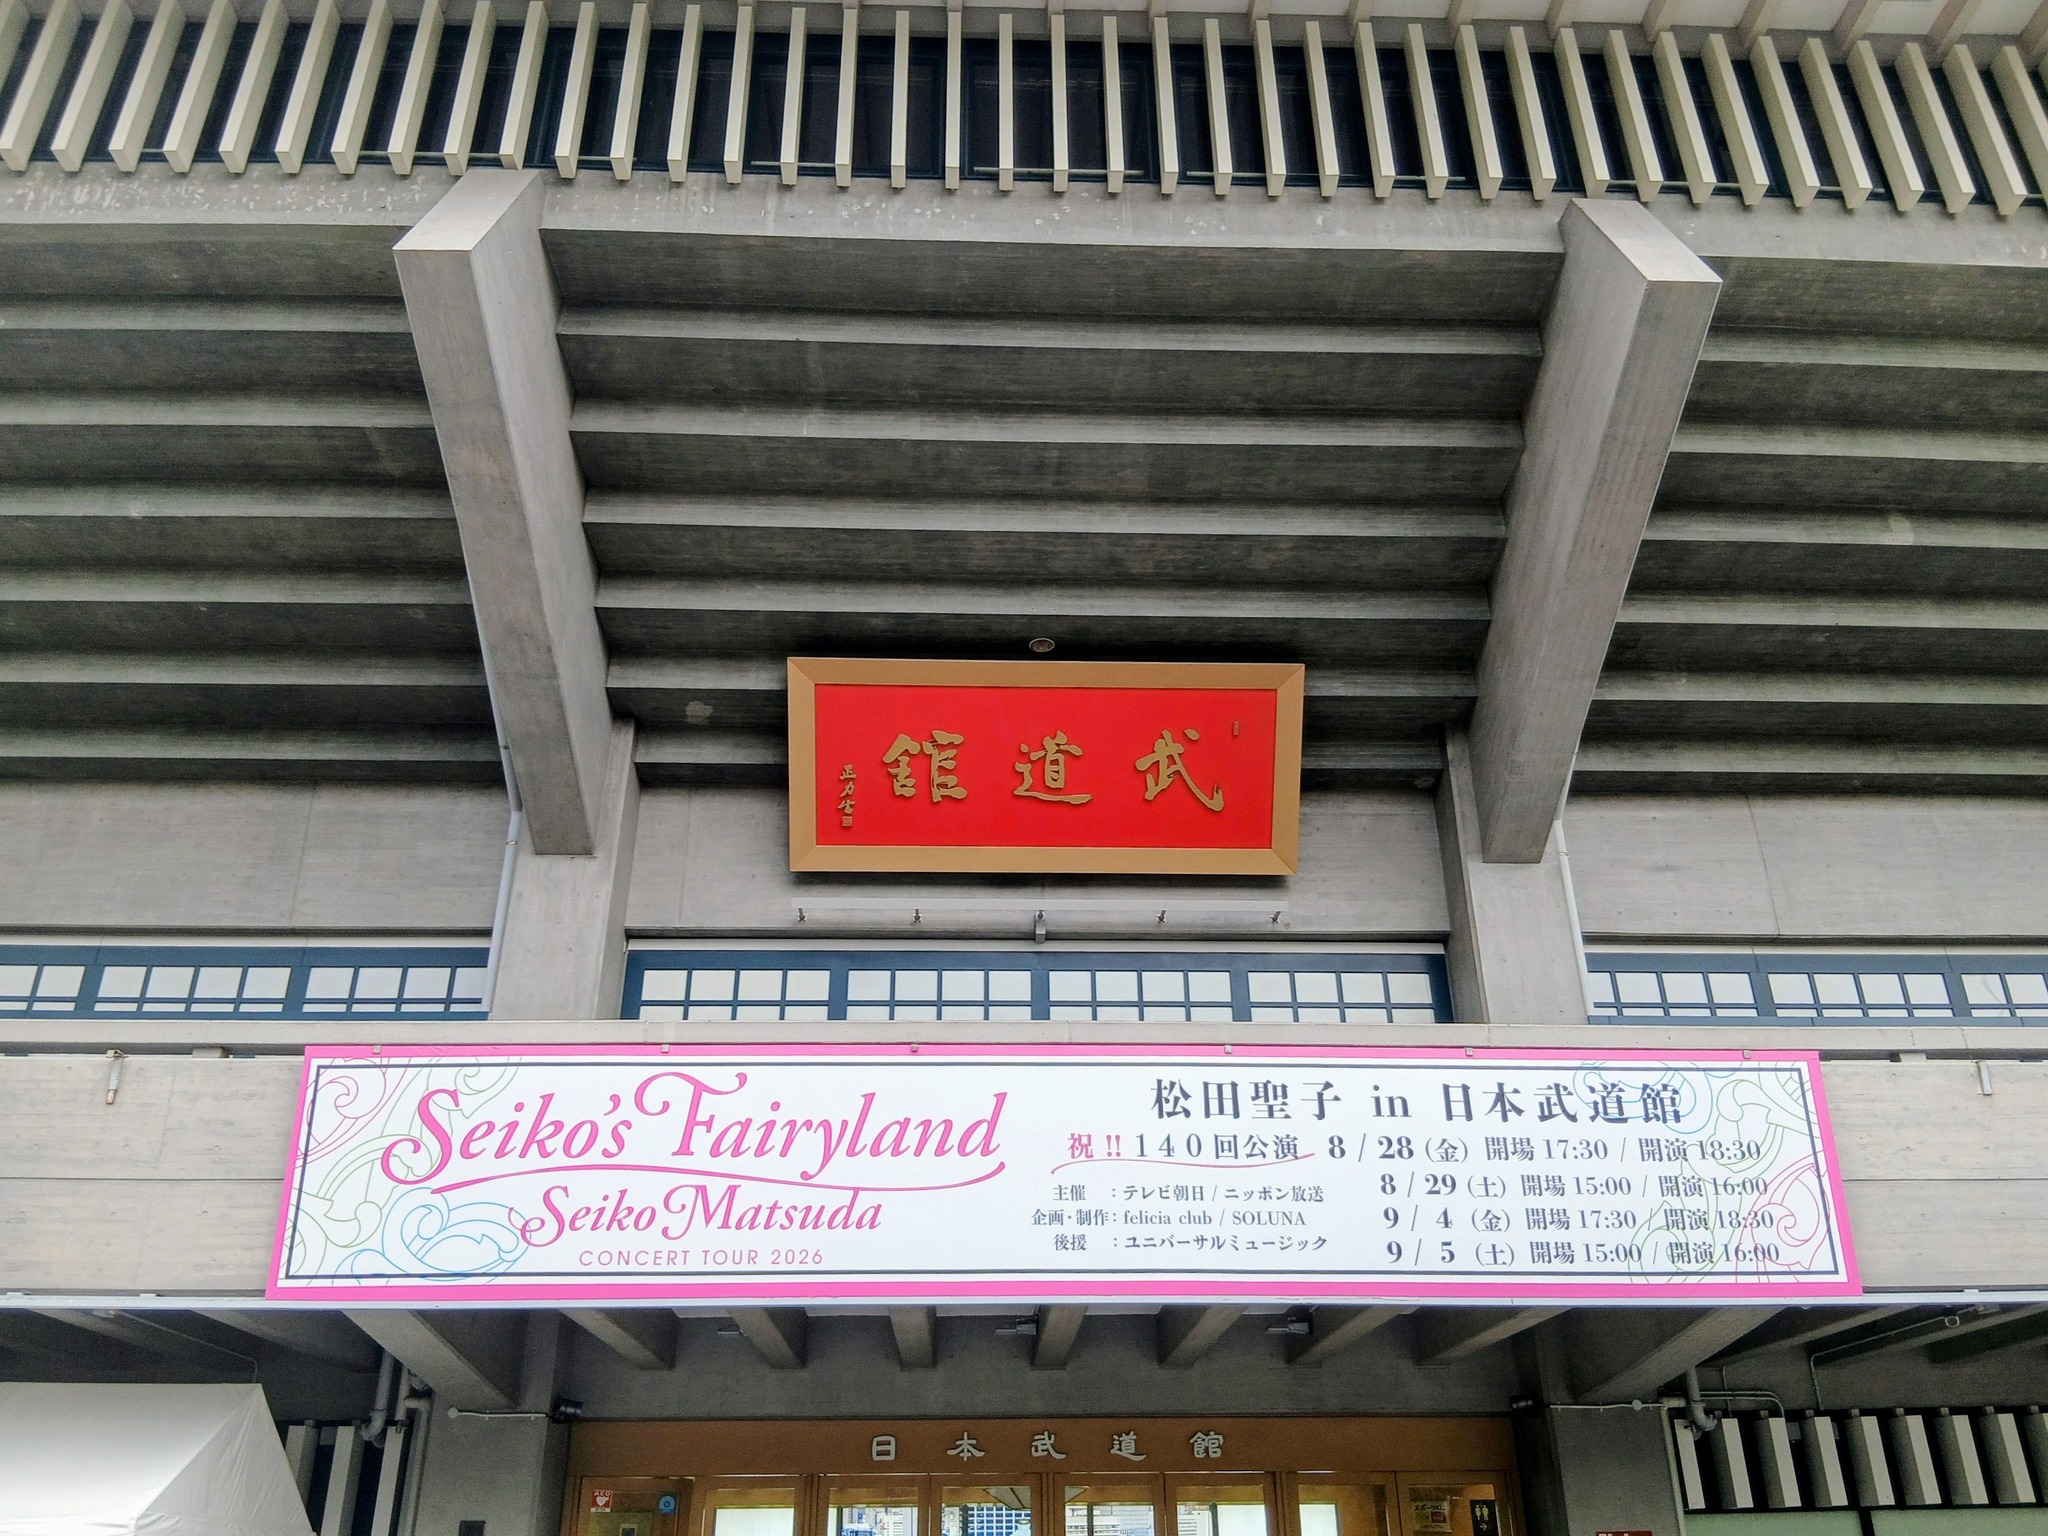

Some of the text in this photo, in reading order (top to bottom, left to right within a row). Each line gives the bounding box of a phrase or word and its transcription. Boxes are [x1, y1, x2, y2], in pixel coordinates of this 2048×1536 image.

[1150, 1078, 1682, 1125] 松田聖子 in 日本武道館
[380, 1072, 1007, 1184] Seiko's Fairyland
[1136, 1133, 1299, 1160] 140回公演
[1484, 1136, 1535, 1161] 開場
[1543, 1139, 1608, 1160] 17:30
[1638, 1138, 1688, 1162] 開演
[1697, 1140, 1761, 1160] 18:30
[1053, 1184, 1086, 1201] 主催
[1123, 1185, 1204, 1201] テレビ朝日
[1224, 1185, 1324, 1202] ニッポン放送
[1520, 1174, 1566, 1197] 開場
[1573, 1176, 1632, 1195] 15:00
[1658, 1175, 1704, 1198] 開演
[1710, 1177, 1768, 1196] 16:00
[508, 1184, 882, 1247] Seiko Matsuda
[1123, 1210, 1172, 1225] felicia
[1179, 1211, 1212, 1225] club
[1232, 1210, 1306, 1226] SOLUNA
[1525, 1207, 1570, 1230] 開場
[1578, 1209, 1637, 1229] 17:30
[1664, 1208, 1709, 1231] 開演
[1717, 1210, 1774, 1229] 18:30
[1053, 1233, 1087, 1251] 後援
[1124, 1234, 1328, 1251] ユニバーサルミュージック
[1530, 1241, 1575, 1264] 開場
[1582, 1243, 1642, 1262] 15:00
[1668, 1242, 1714, 1264] 開演
[1721, 1243, 1780, 1262] 16:00
[579, 1249, 823, 1266] CONCERT TOUR 2026
[872, 1431, 1225, 1462] 日本武道館
